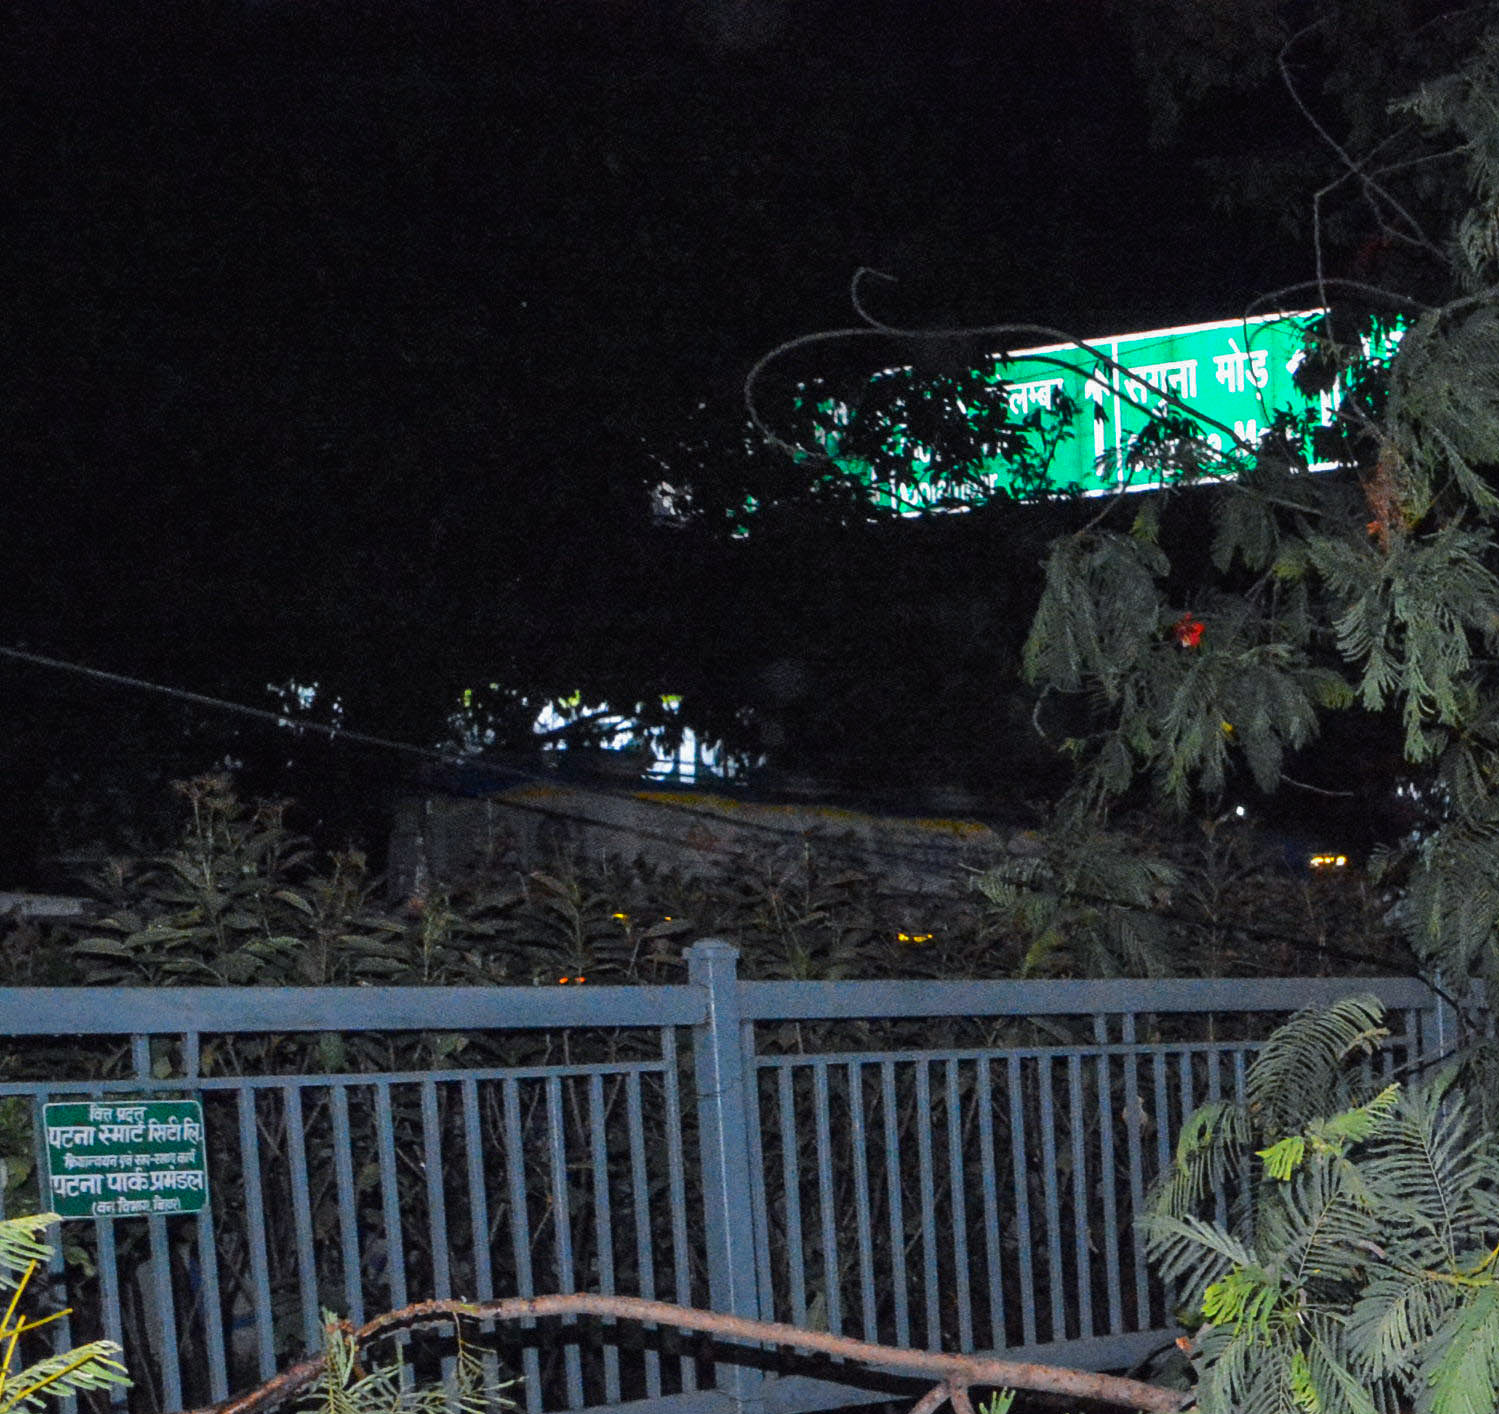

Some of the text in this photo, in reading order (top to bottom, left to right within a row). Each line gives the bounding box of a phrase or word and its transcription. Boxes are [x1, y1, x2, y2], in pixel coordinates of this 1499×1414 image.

[49, 1127, 96, 1148] पटना
[99, 1121, 145, 1145] स्मार्ट
[147, 1116, 181, 1144] सिटी
[52, 1165, 204, 1197] पटना पार्क प्रमंडल
